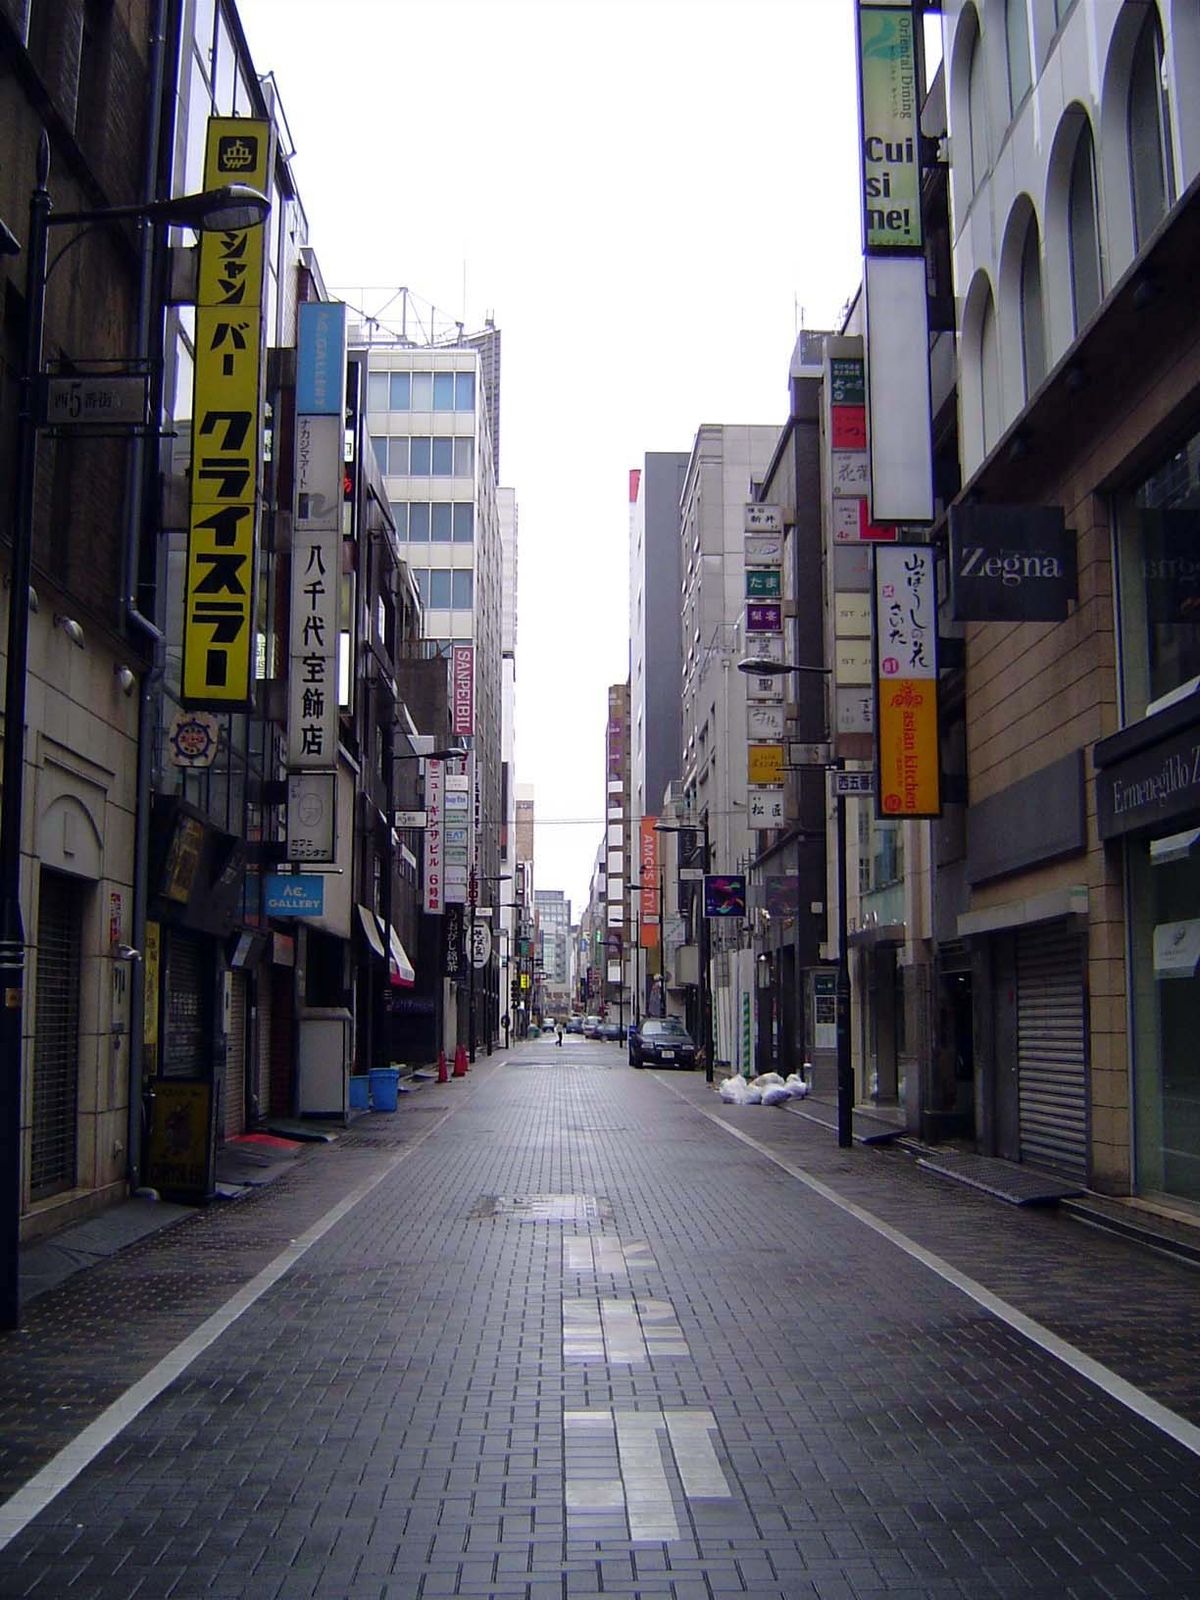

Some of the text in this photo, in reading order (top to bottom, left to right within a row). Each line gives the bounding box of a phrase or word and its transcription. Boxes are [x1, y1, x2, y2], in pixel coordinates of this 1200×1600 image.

[899, 17, 915, 119] Oriental Dining
[866, 136, 913, 163] Cui
[866, 172, 890, 198] si
[867, 208, 910, 235] ne!
[193, 411, 252, 687] クライスラー
[959, 547, 1063, 587] Zegna
[904, 553, 930, 668] 山ぼうしの花
[301, 545, 326, 756] 八千代宝飾店
[903, 711, 919, 809] asian kitchen
[838, 774, 872, 791] 西五番
[1113, 754, 1188, 814] Ermenegildo
[268, 899, 322, 909] GALLERY
[643, 884, 655, 916] STYL
